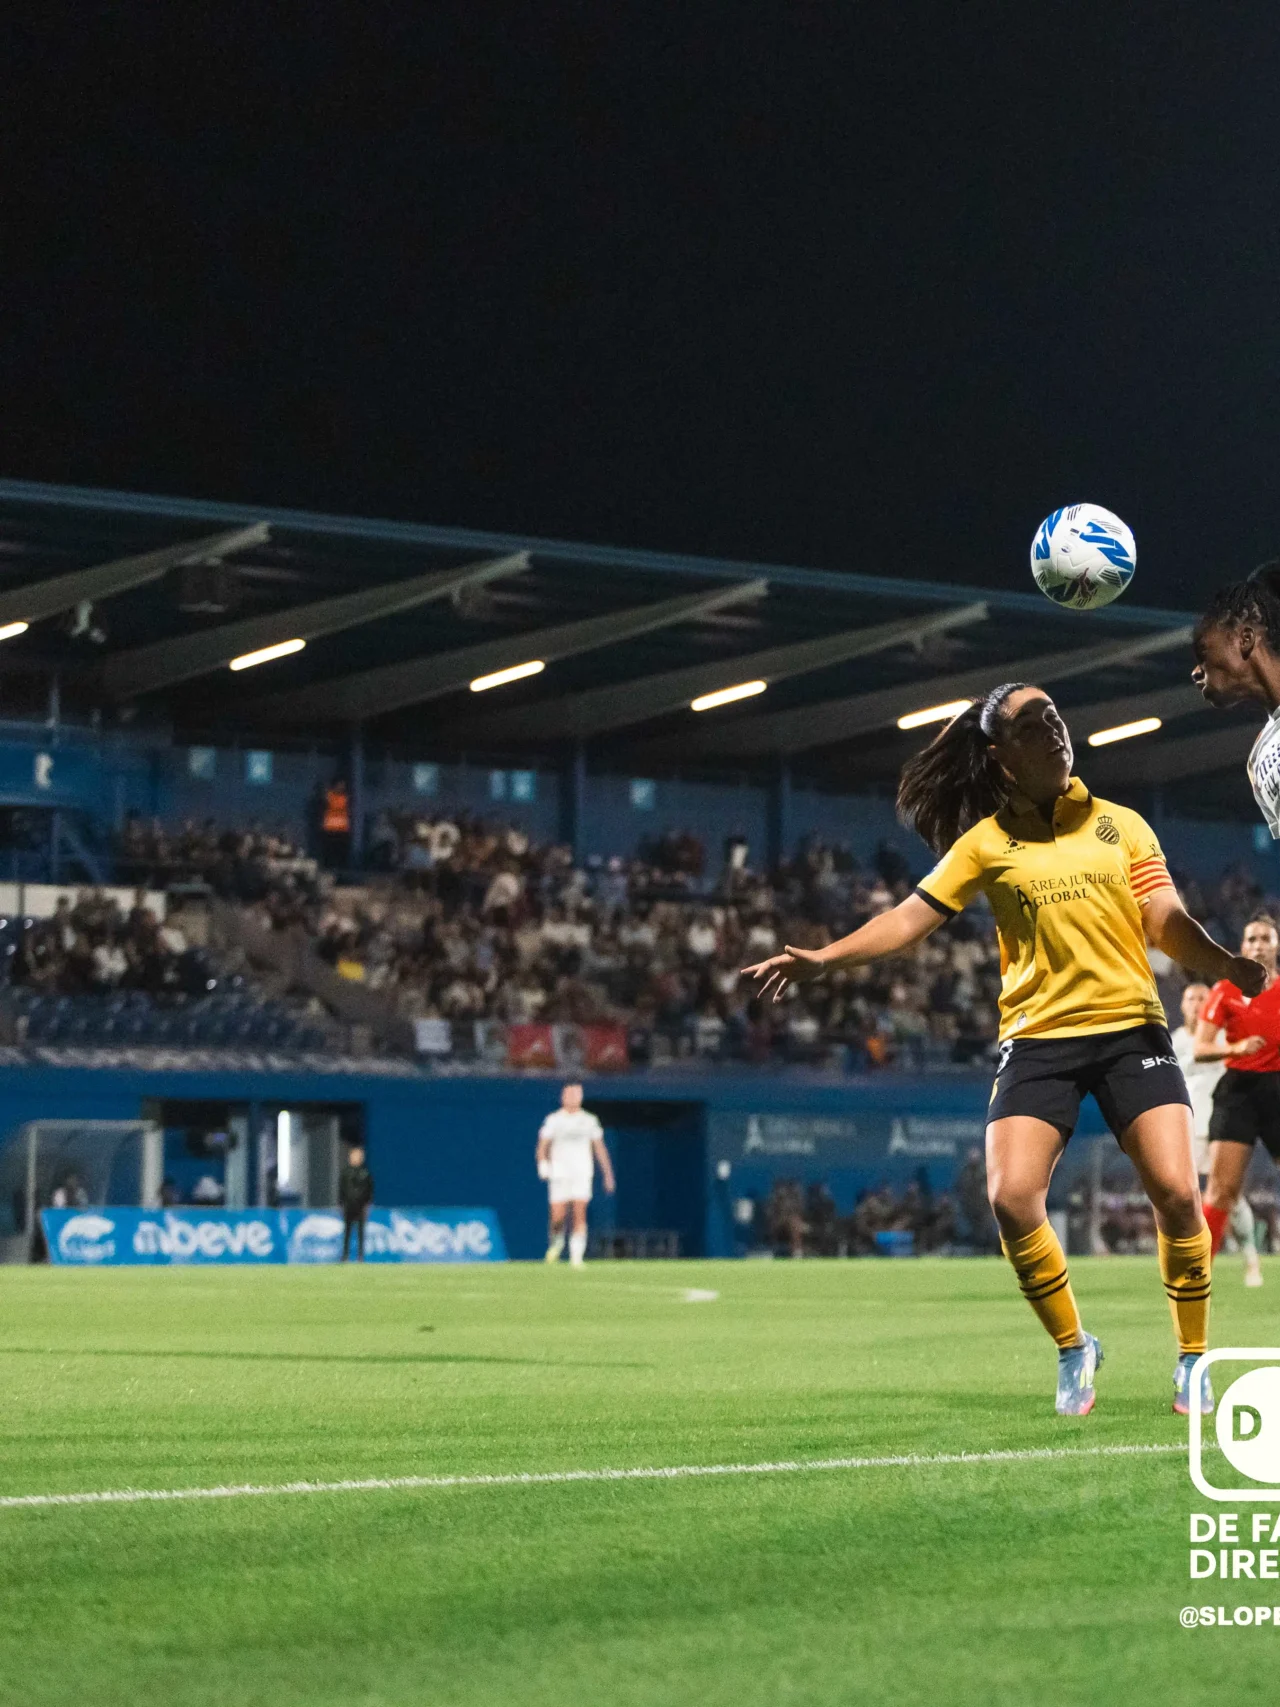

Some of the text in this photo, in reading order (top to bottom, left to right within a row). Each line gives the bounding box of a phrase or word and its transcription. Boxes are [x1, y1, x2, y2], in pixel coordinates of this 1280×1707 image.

[1069, 870, 1127, 889] JURÍDICA
[1033, 888, 1091, 908] GLOBAL
[1141, 1055, 1180, 1070] SKO
